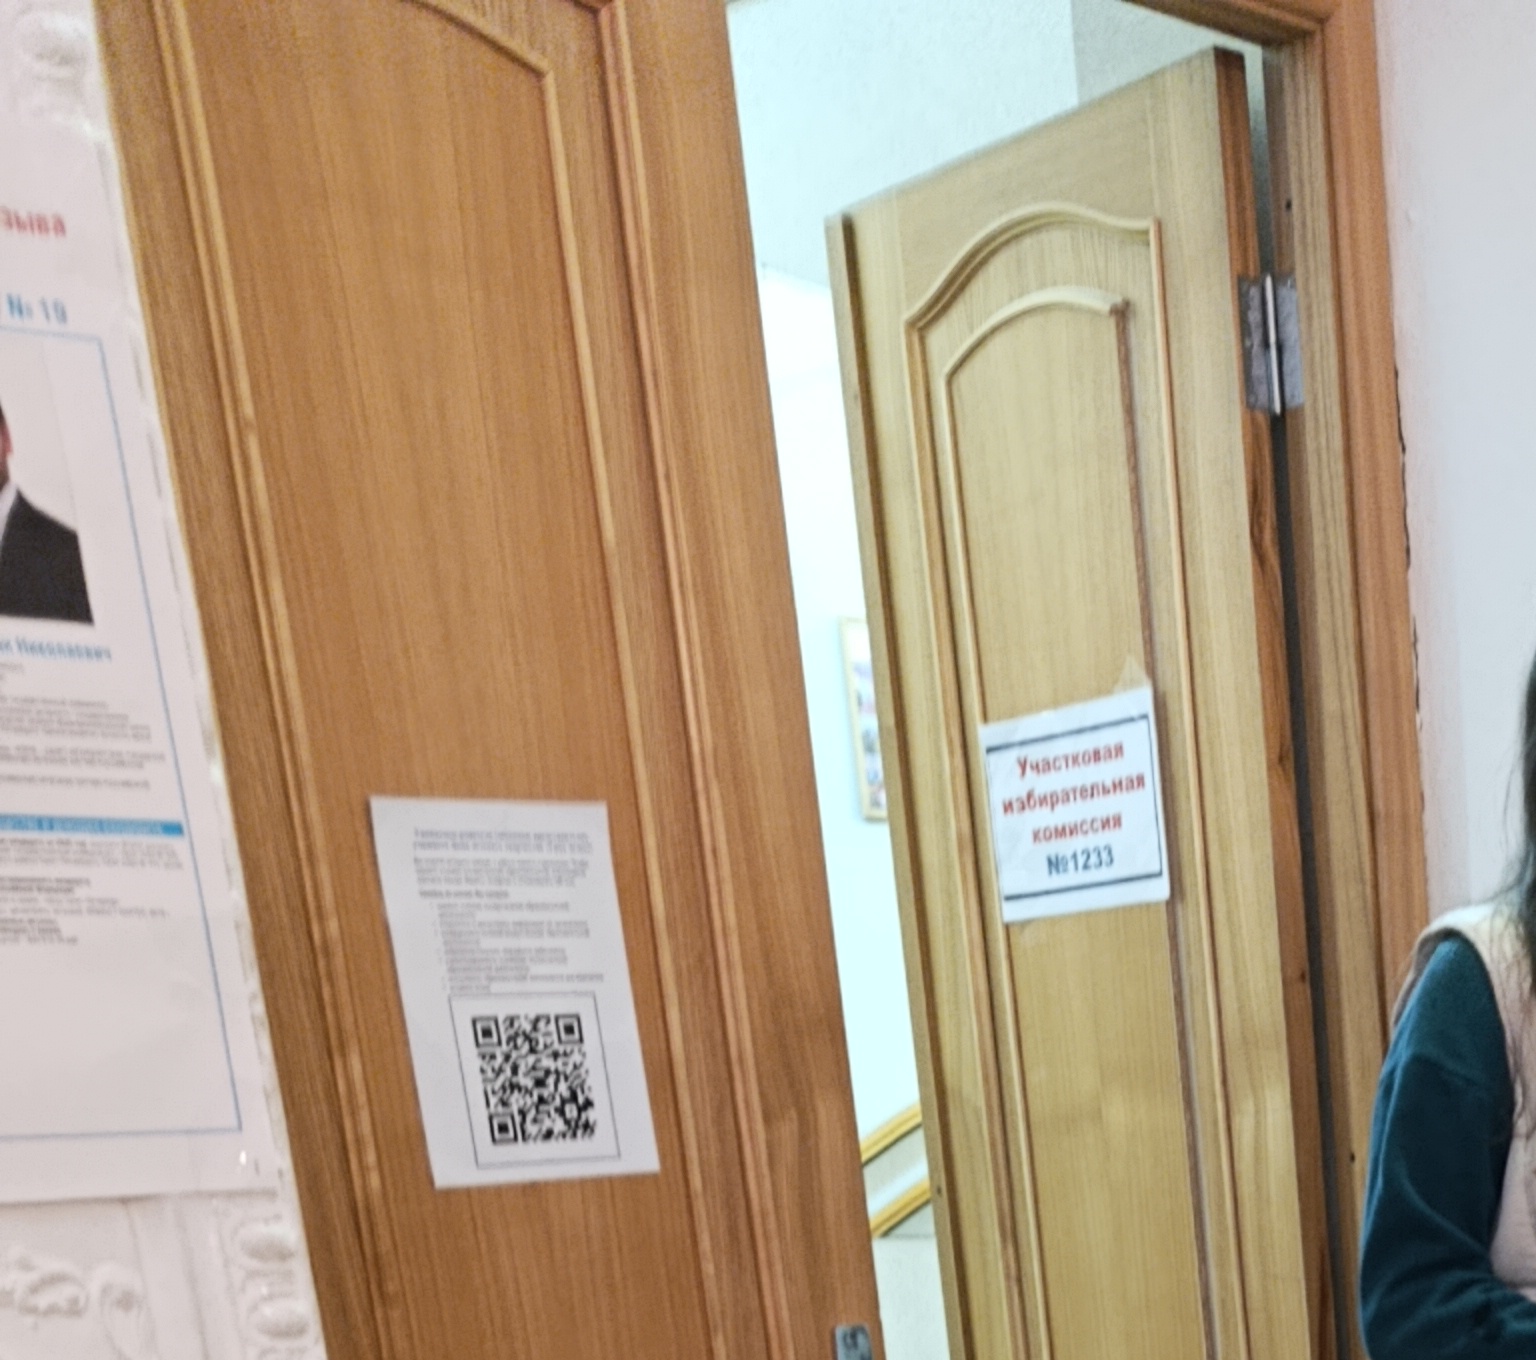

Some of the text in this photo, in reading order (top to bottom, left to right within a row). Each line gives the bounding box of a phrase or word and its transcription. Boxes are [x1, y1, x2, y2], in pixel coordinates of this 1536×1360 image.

[1017, 742, 1124, 780] Участковая
[1002, 772, 1146, 815] избирательная
[1032, 813, 1123, 845] комиссия
[1046, 844, 1115, 876] №1233
